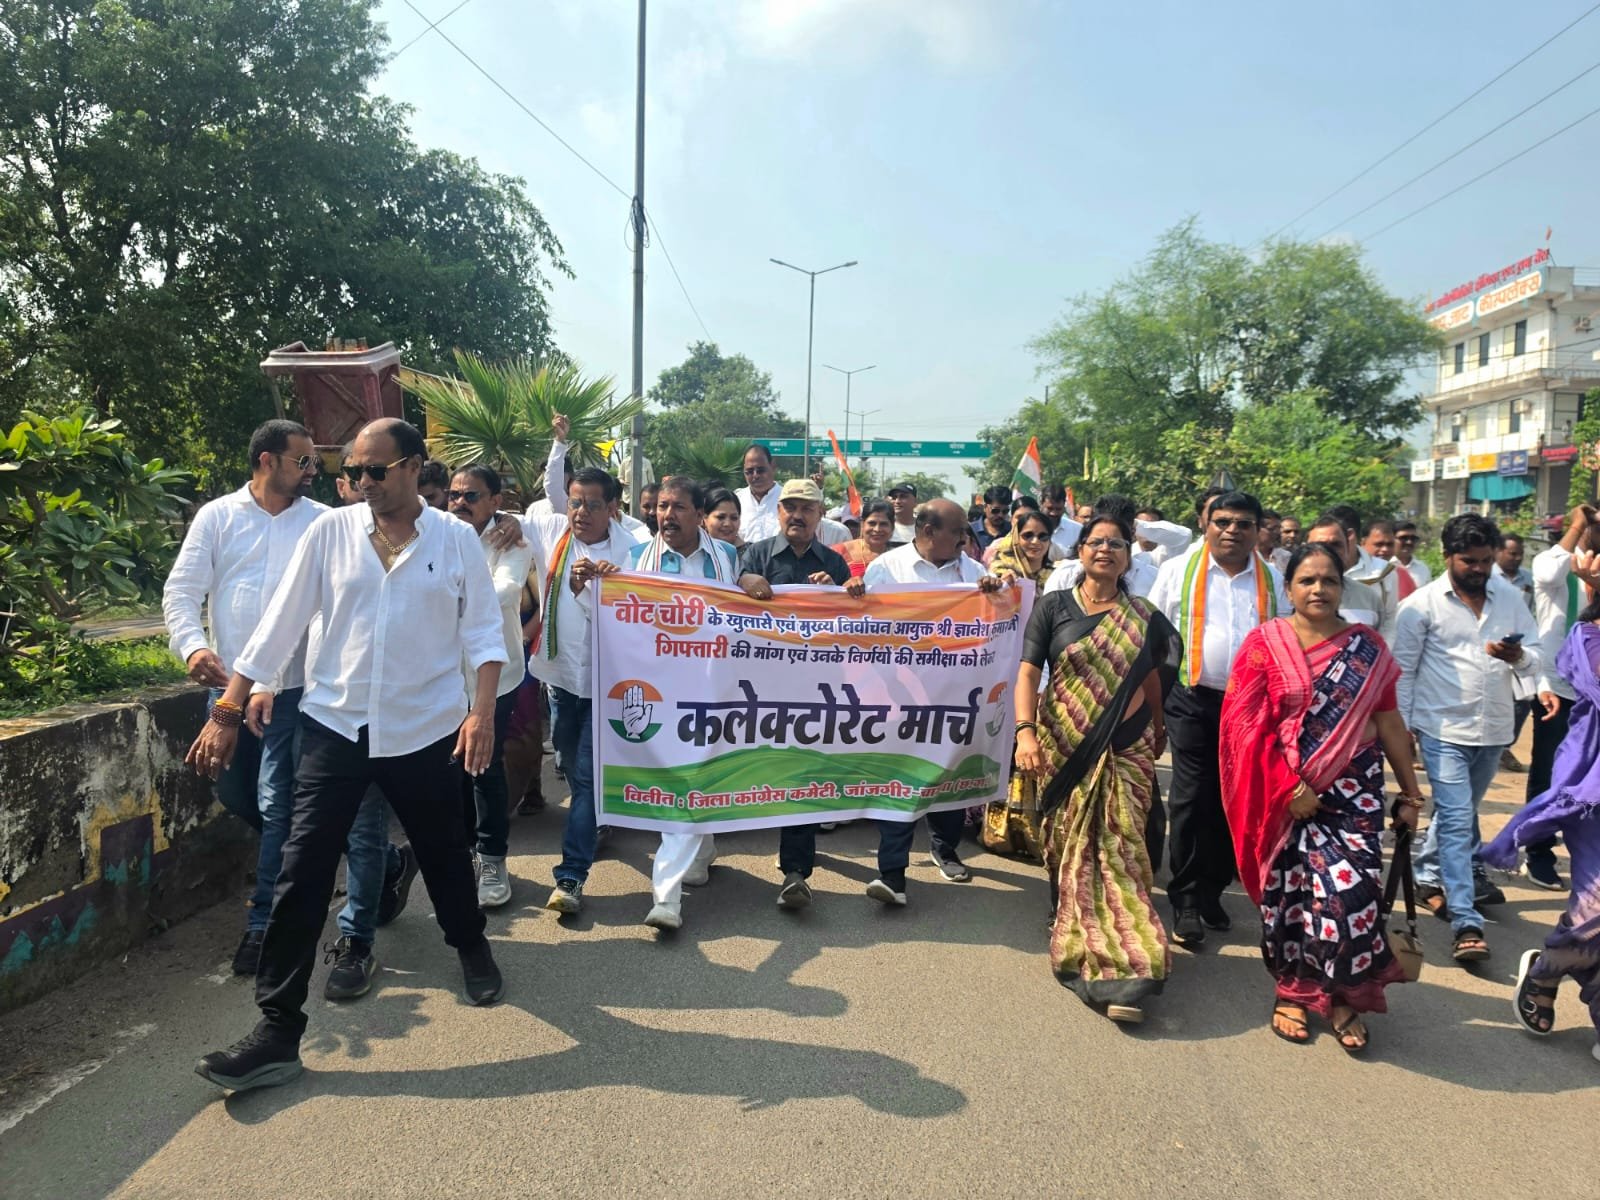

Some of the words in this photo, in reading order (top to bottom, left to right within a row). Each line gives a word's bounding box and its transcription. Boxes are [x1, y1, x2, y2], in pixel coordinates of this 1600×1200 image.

[615, 594, 655, 624] वोट
[659, 595, 705, 625] चोरी
[708, 607, 723, 626] के
[726, 613, 772, 633] खुलासे
[776, 615, 797, 633] एवं
[799, 620, 834, 637] मुख्य
[838, 617, 892, 635] निर्वाचन
[894, 622, 935, 641] आयुक्त
[937, 618, 952, 636] श्री
[954, 619, 990, 638] ज्ञानेश
[656, 632, 728, 659] गिफ्तारी
[731, 640, 750, 659] की
[754, 642, 784, 661] मांग
[787, 644, 811, 664] एवं
[811, 645, 846, 664] उनके
[848, 646, 891, 665] निर्णयों
[895, 647, 913, 665] की
[916, 648, 957, 667] समीक्षा
[960, 649, 978, 668] को
[676, 679, 891, 747] कलेक्टोरेट
[897, 687, 983, 746] मार्च
[624, 784, 675, 807] विनीत
[688, 791, 731, 808] जिला
[734, 784, 786, 806] कांग्रेस
